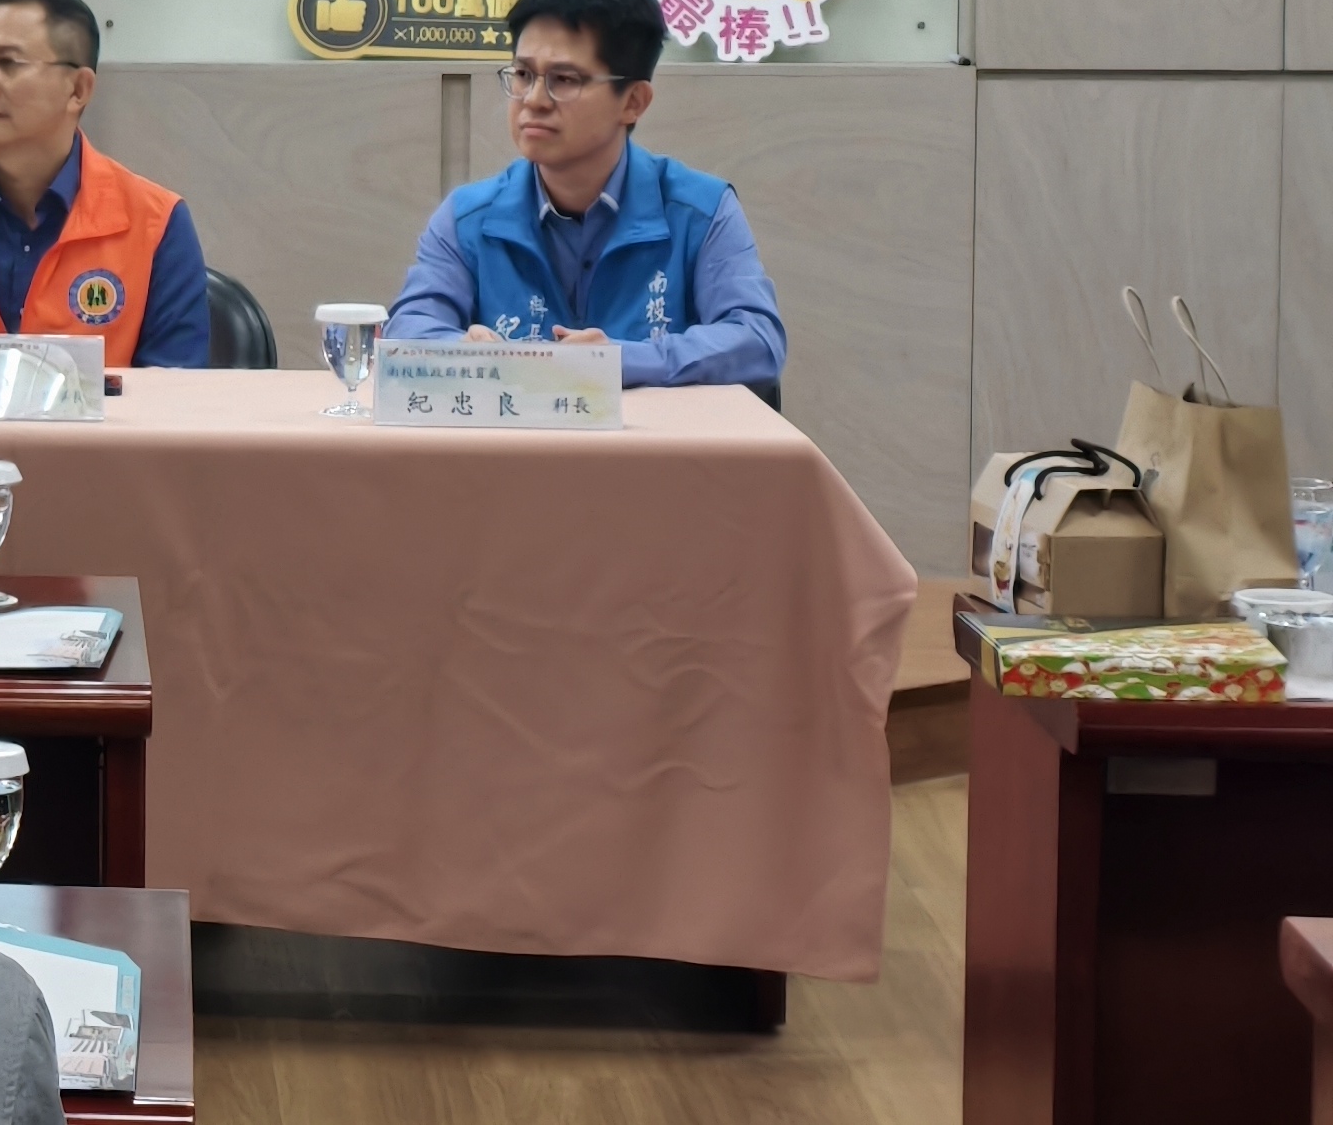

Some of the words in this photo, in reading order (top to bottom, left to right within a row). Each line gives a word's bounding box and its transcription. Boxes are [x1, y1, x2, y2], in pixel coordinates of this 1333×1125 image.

[407, 391, 521, 417] 紀忠良
[554, 396, 591, 415] 科長
